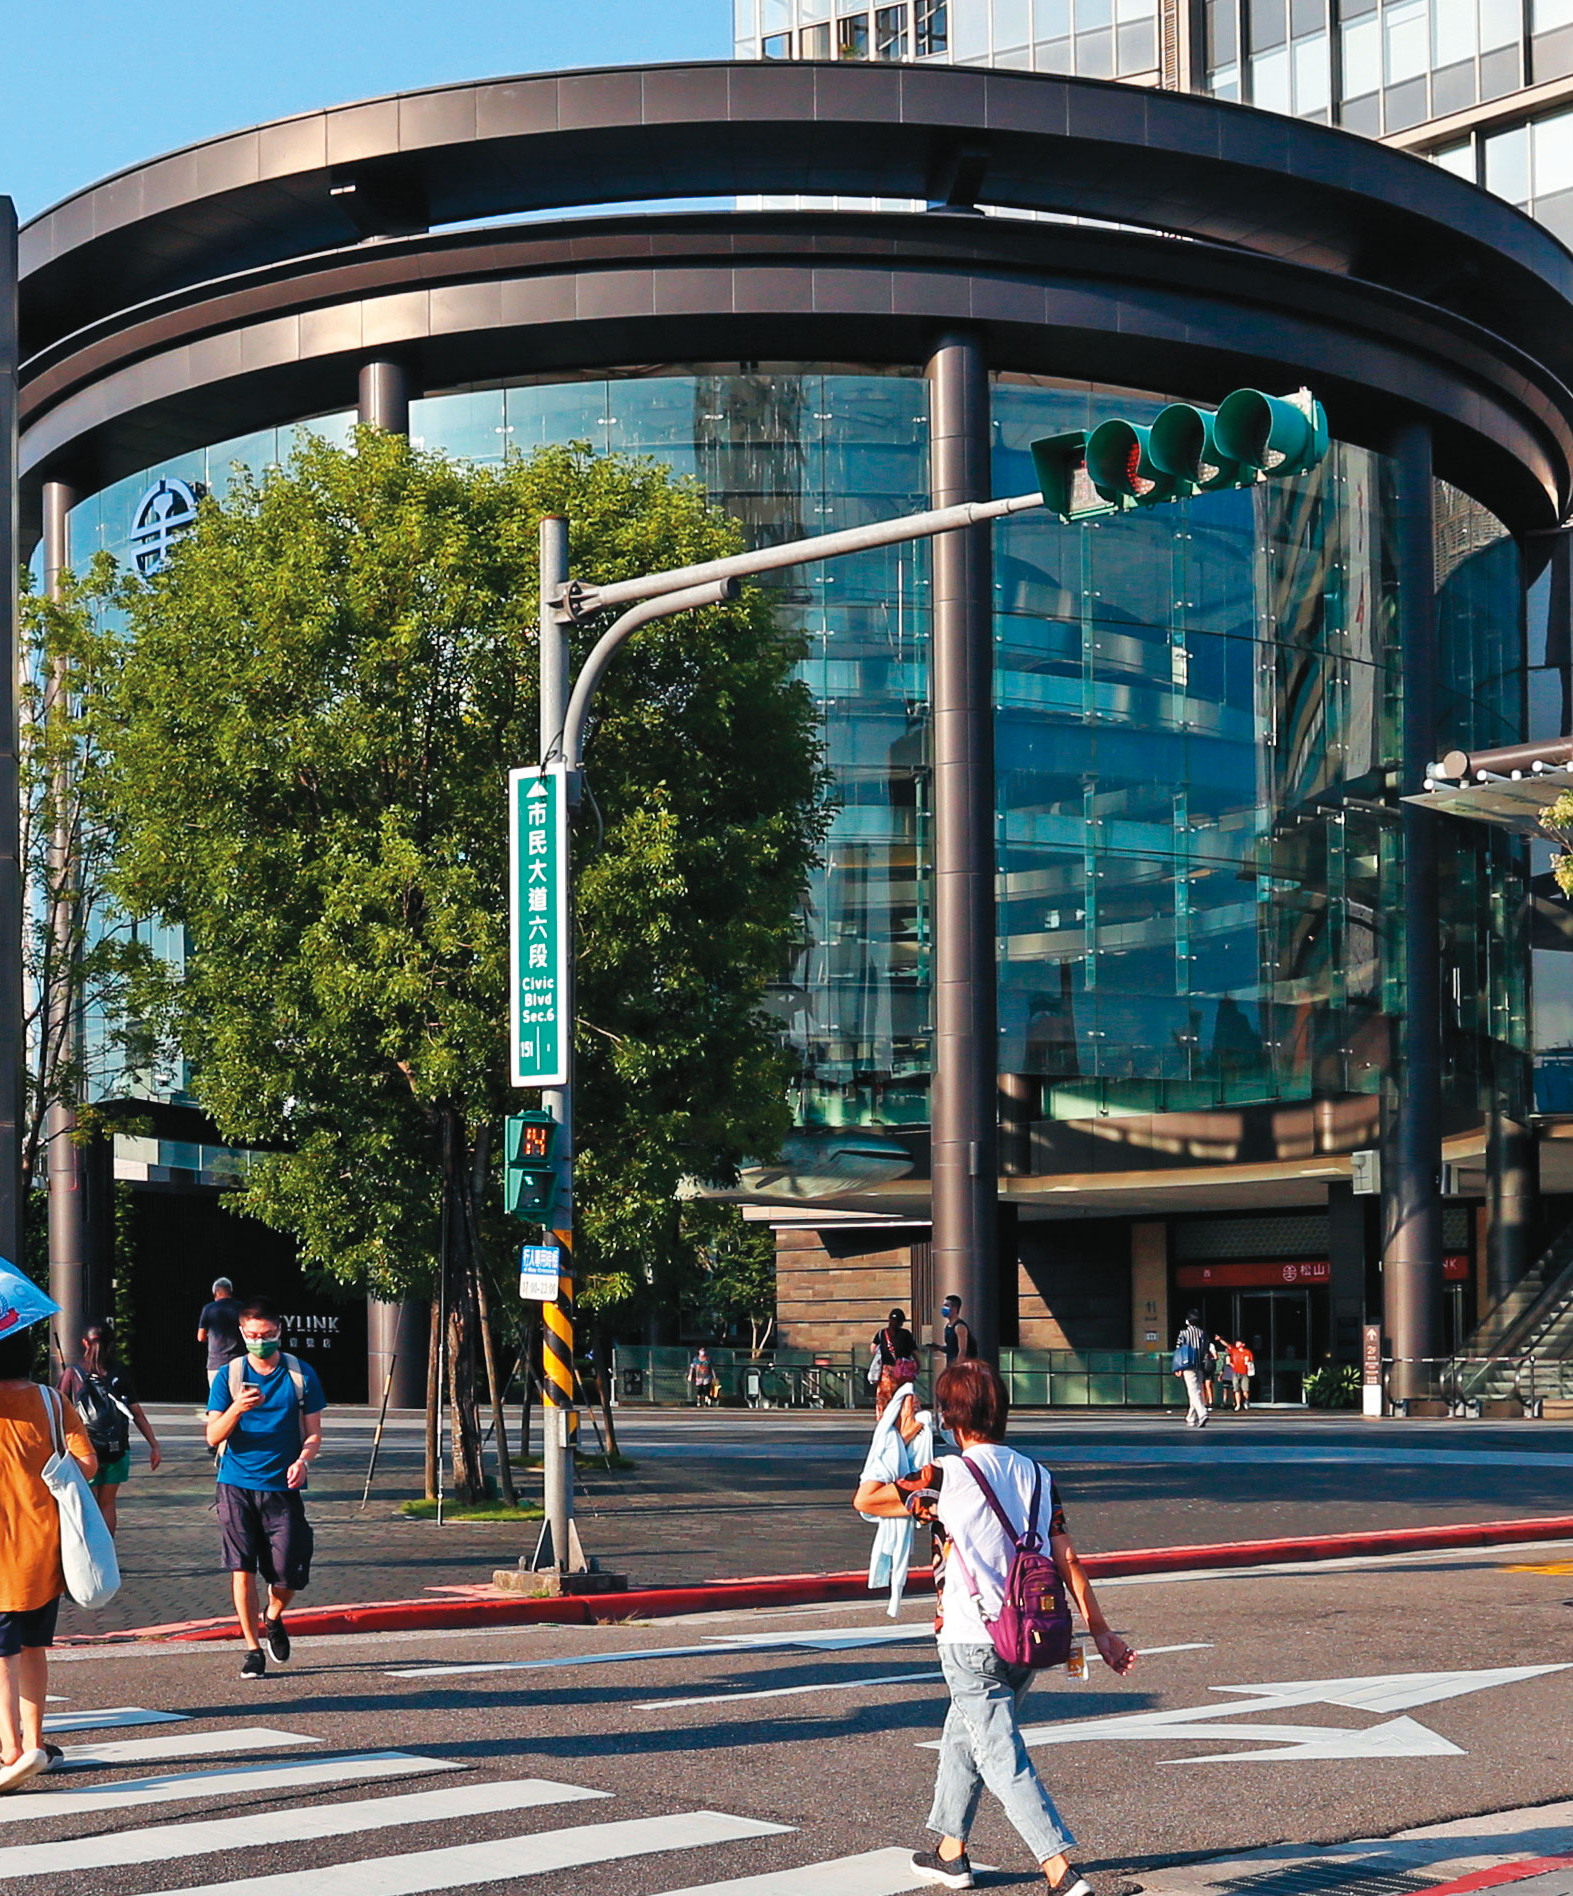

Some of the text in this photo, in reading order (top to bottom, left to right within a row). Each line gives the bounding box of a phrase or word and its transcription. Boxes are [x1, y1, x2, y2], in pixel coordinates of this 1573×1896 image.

[527, 802, 548, 969] 市民大道六段
[522, 976, 554, 991] Civic
[525, 992, 552, 1007] Blvd
[522, 1008, 555, 1024] Sec.6
[279, 1315, 339, 1333] YLINK
